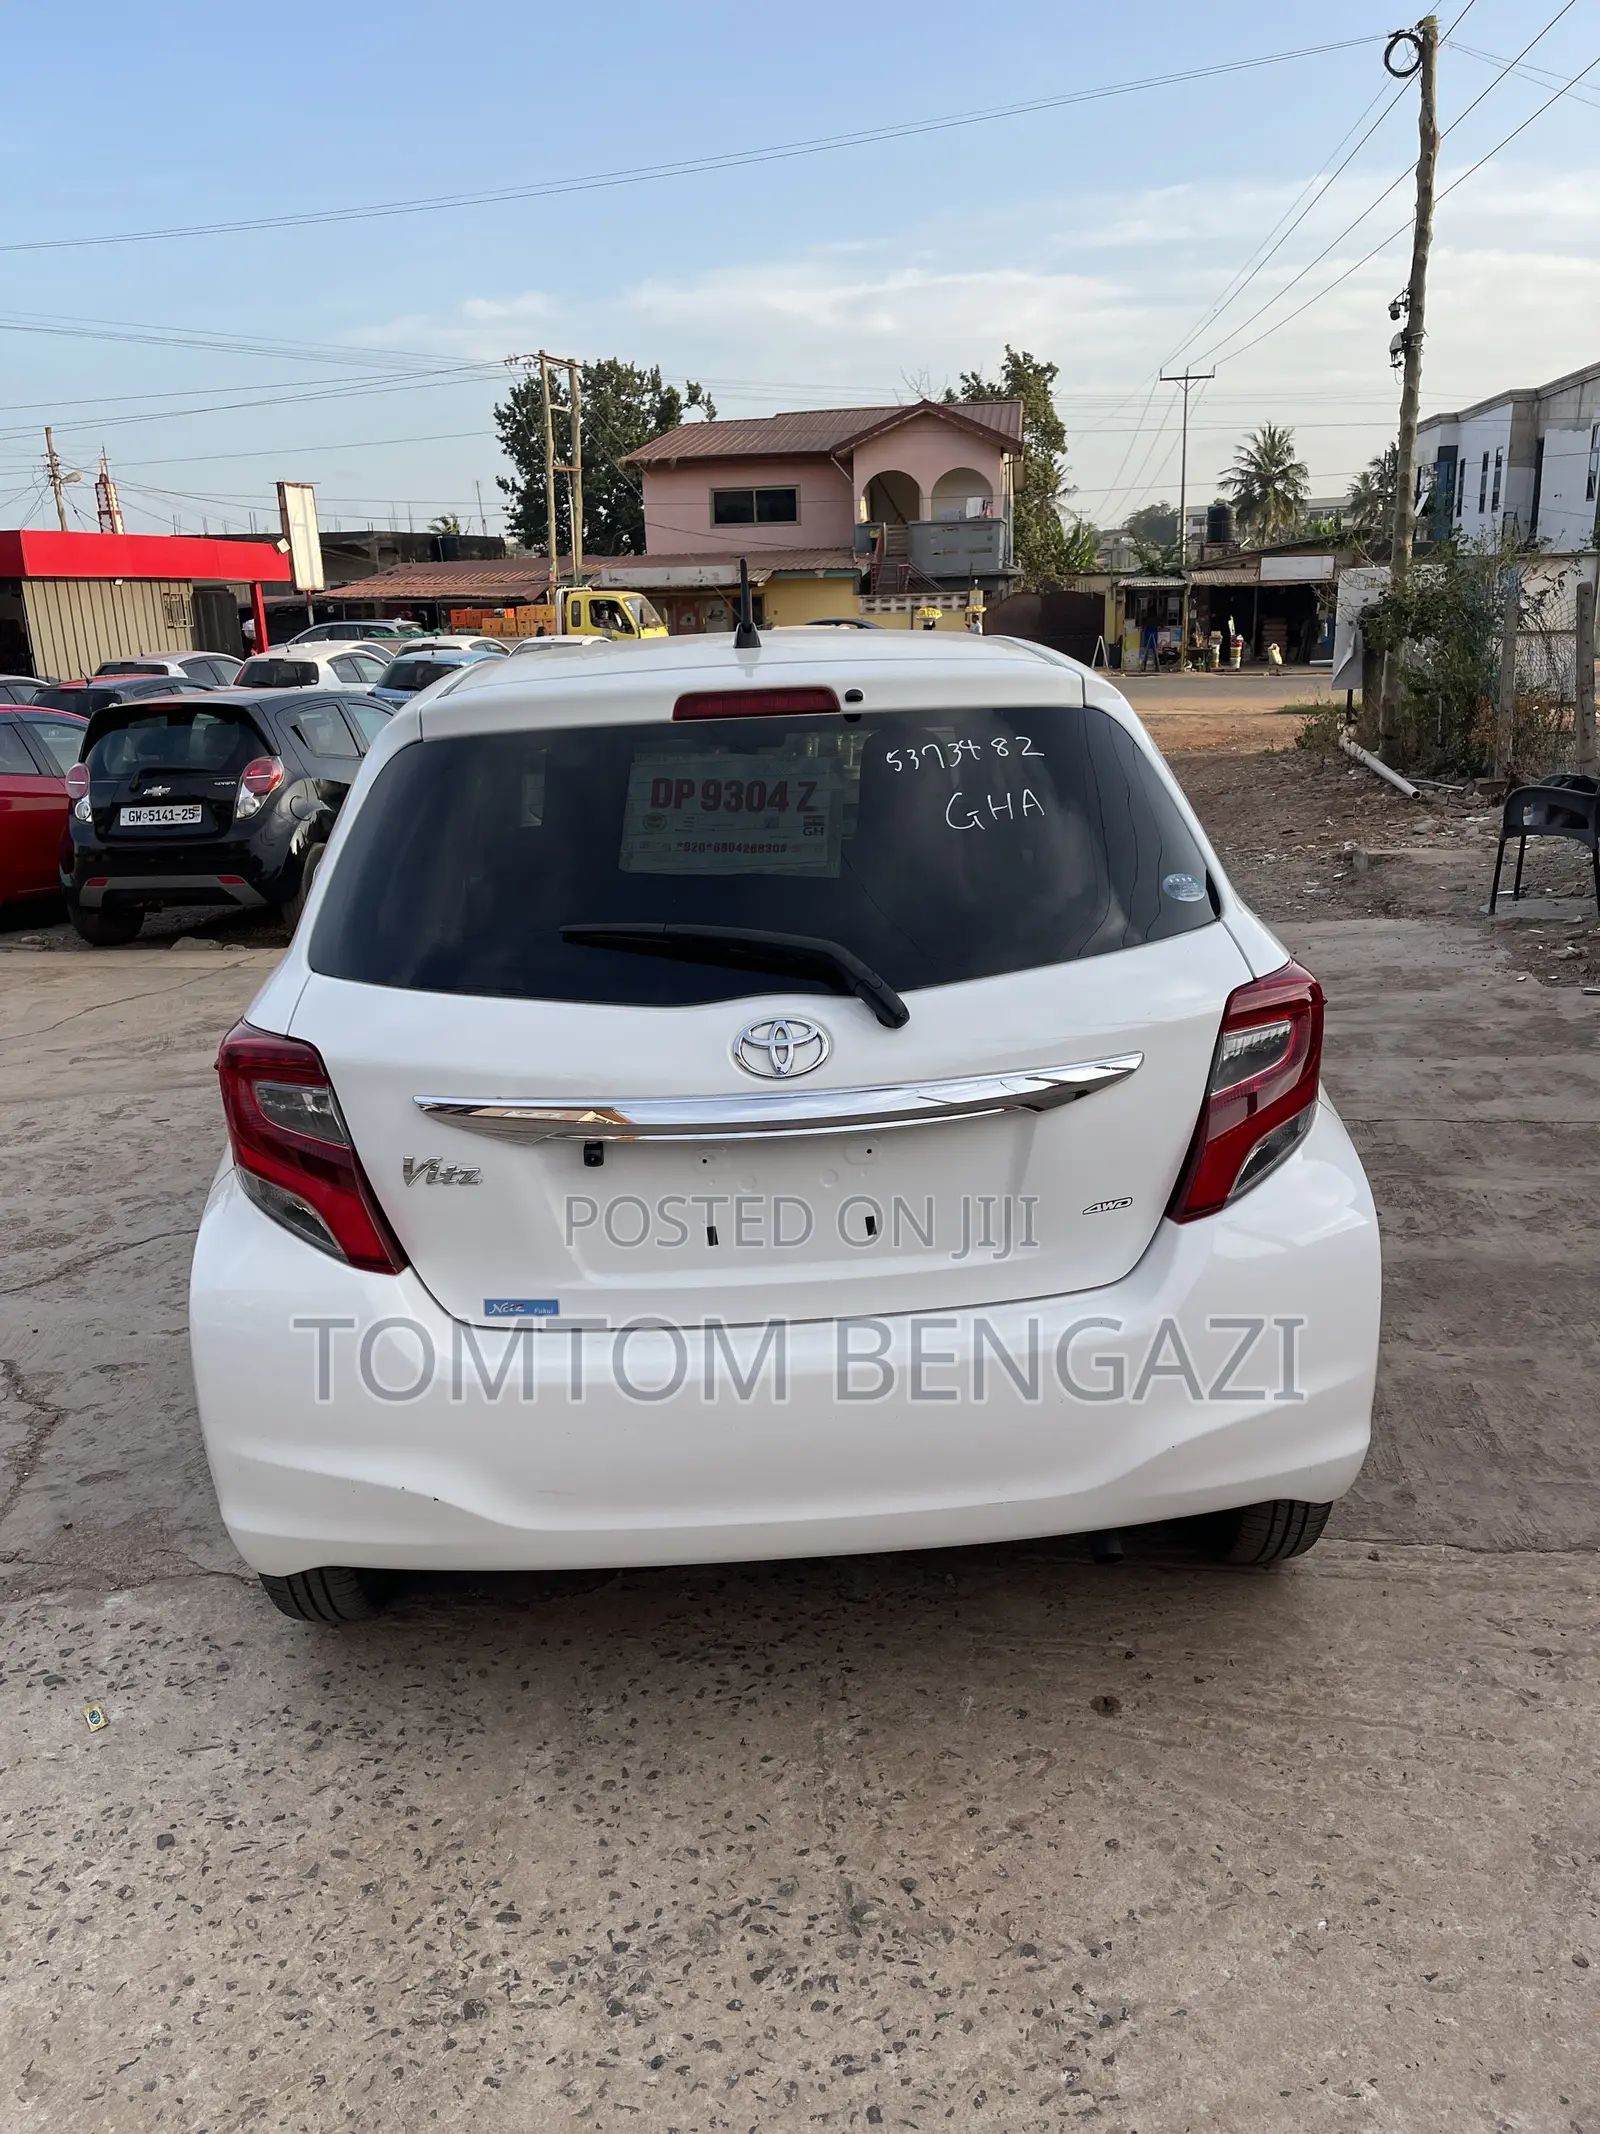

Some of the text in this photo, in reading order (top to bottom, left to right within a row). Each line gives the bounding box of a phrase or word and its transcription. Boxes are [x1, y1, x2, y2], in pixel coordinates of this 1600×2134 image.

[651, 778, 817, 813] DP 9304 Z
[945, 789, 1045, 830] GHA
[803, 826, 824, 836] GH
[402, 1156, 483, 1187] Vitz
[1083, 1197, 1132, 1215] 4WD
